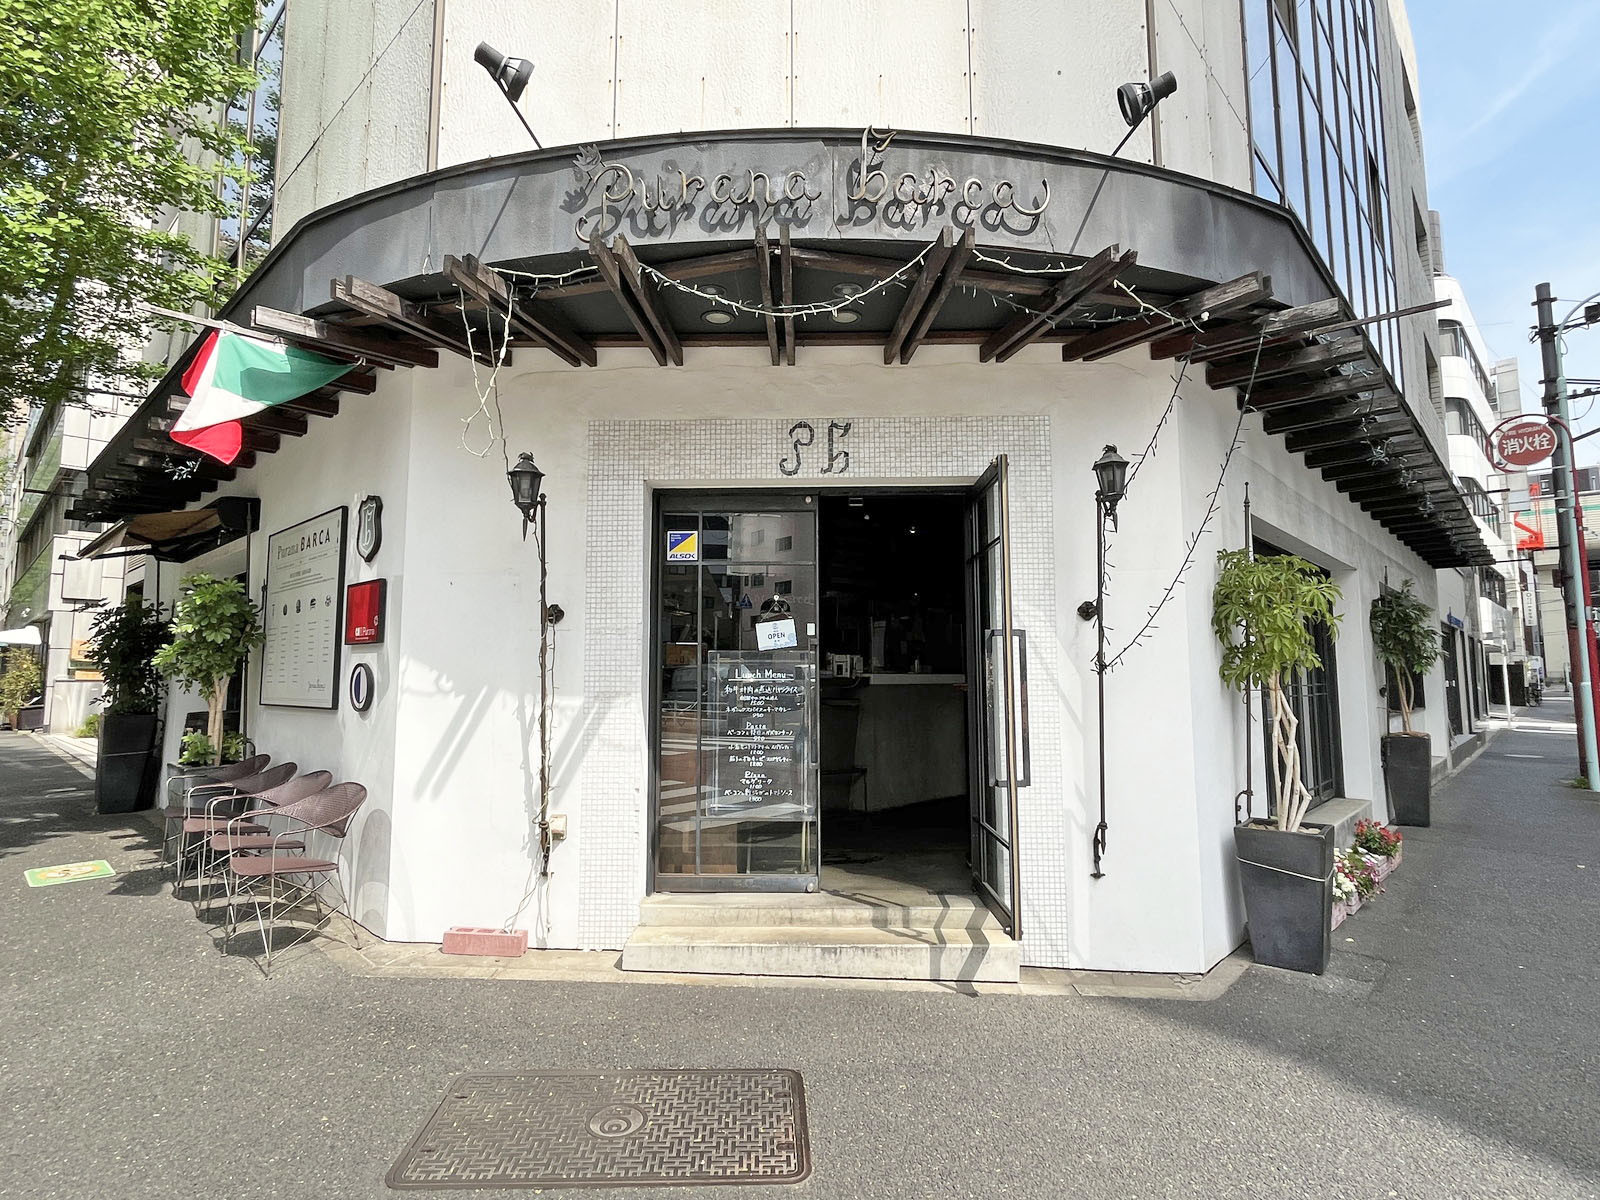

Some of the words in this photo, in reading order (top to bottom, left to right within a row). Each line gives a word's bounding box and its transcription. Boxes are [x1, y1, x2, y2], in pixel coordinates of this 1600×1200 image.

[1501, 432, 1552, 456] 消火栓
[300, 527, 331, 552] BARCA
[767, 632, 785, 640] OPEN
[735, 668, 761, 679] Lunch
[764, 668, 787, 679] Menu
[745, 721, 767, 730] Pasta
[744, 770, 767, 779] Pizza
